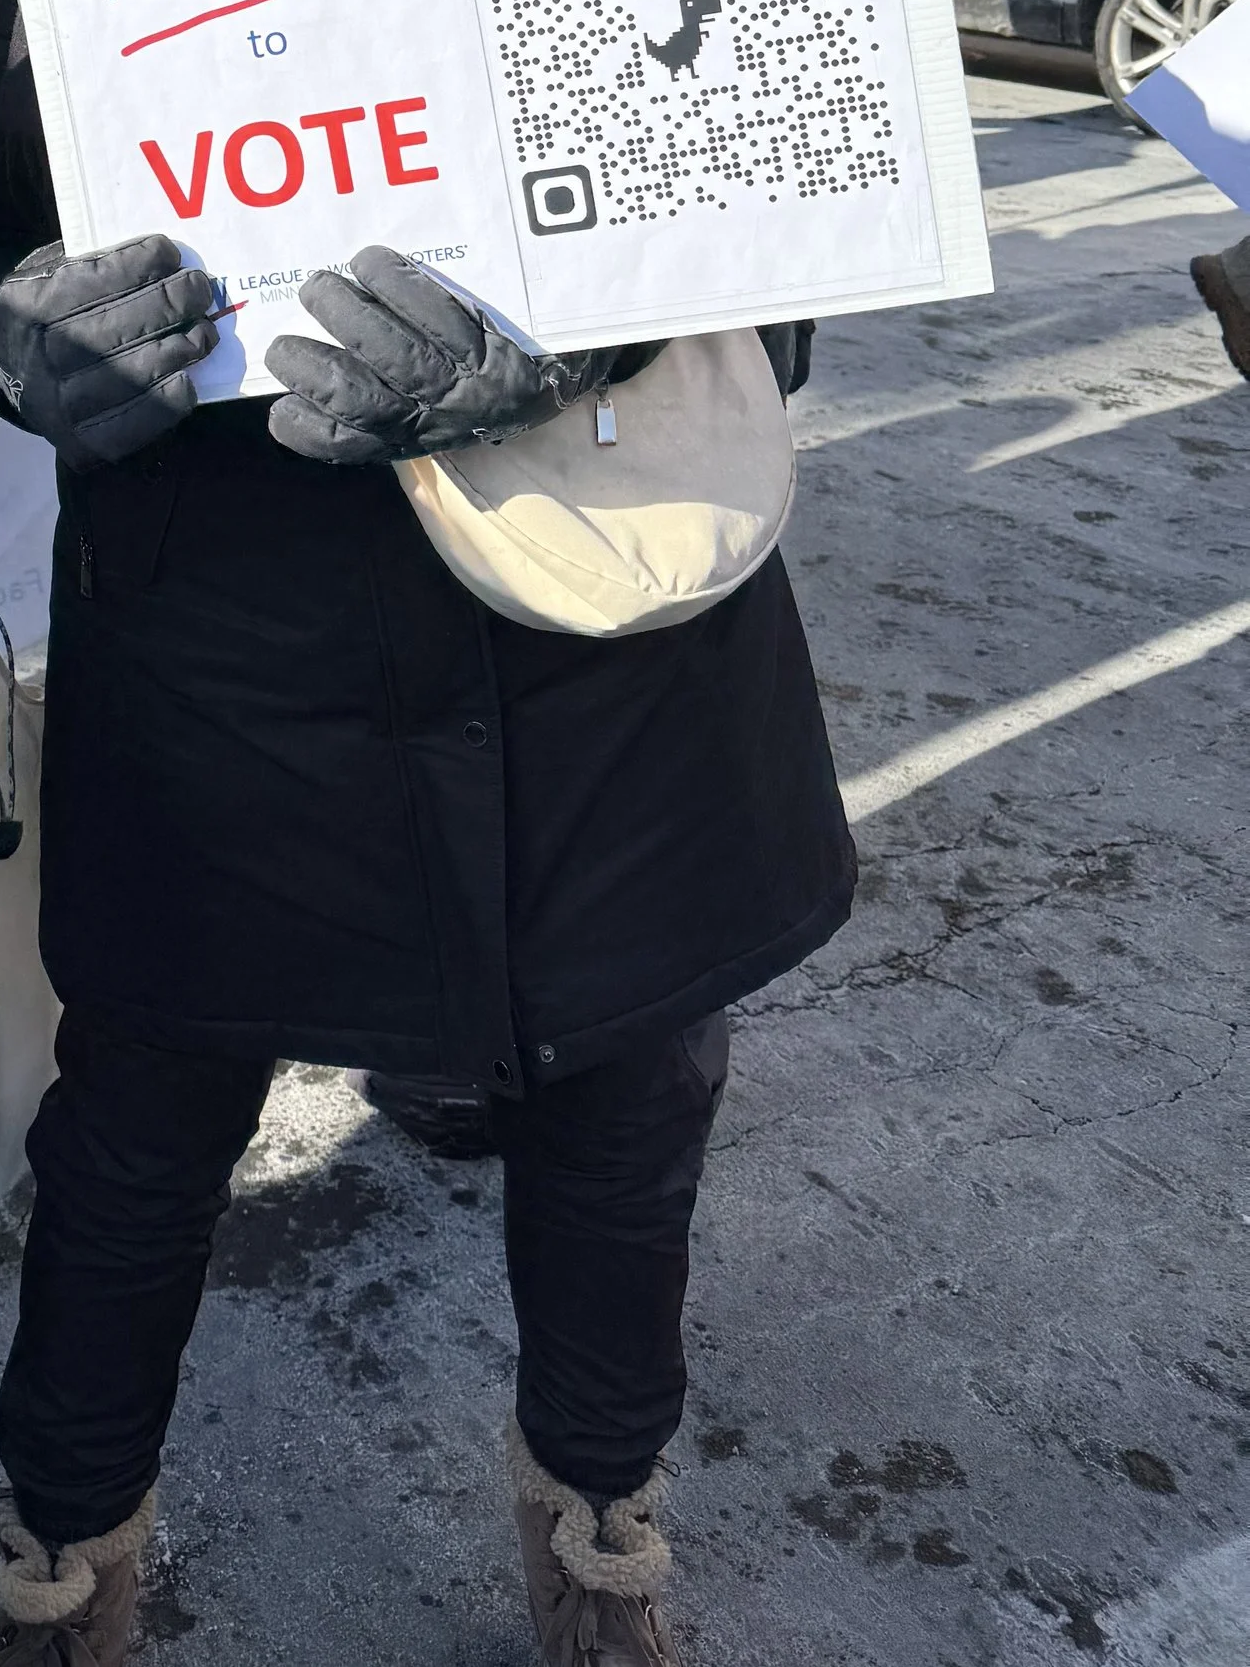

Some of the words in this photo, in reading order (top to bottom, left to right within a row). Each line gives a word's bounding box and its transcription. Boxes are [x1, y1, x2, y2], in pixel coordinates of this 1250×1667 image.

[246, 30, 288, 58] to
[139, 97, 440, 219] VOTE
[238, 269, 303, 291] LEAGUE
